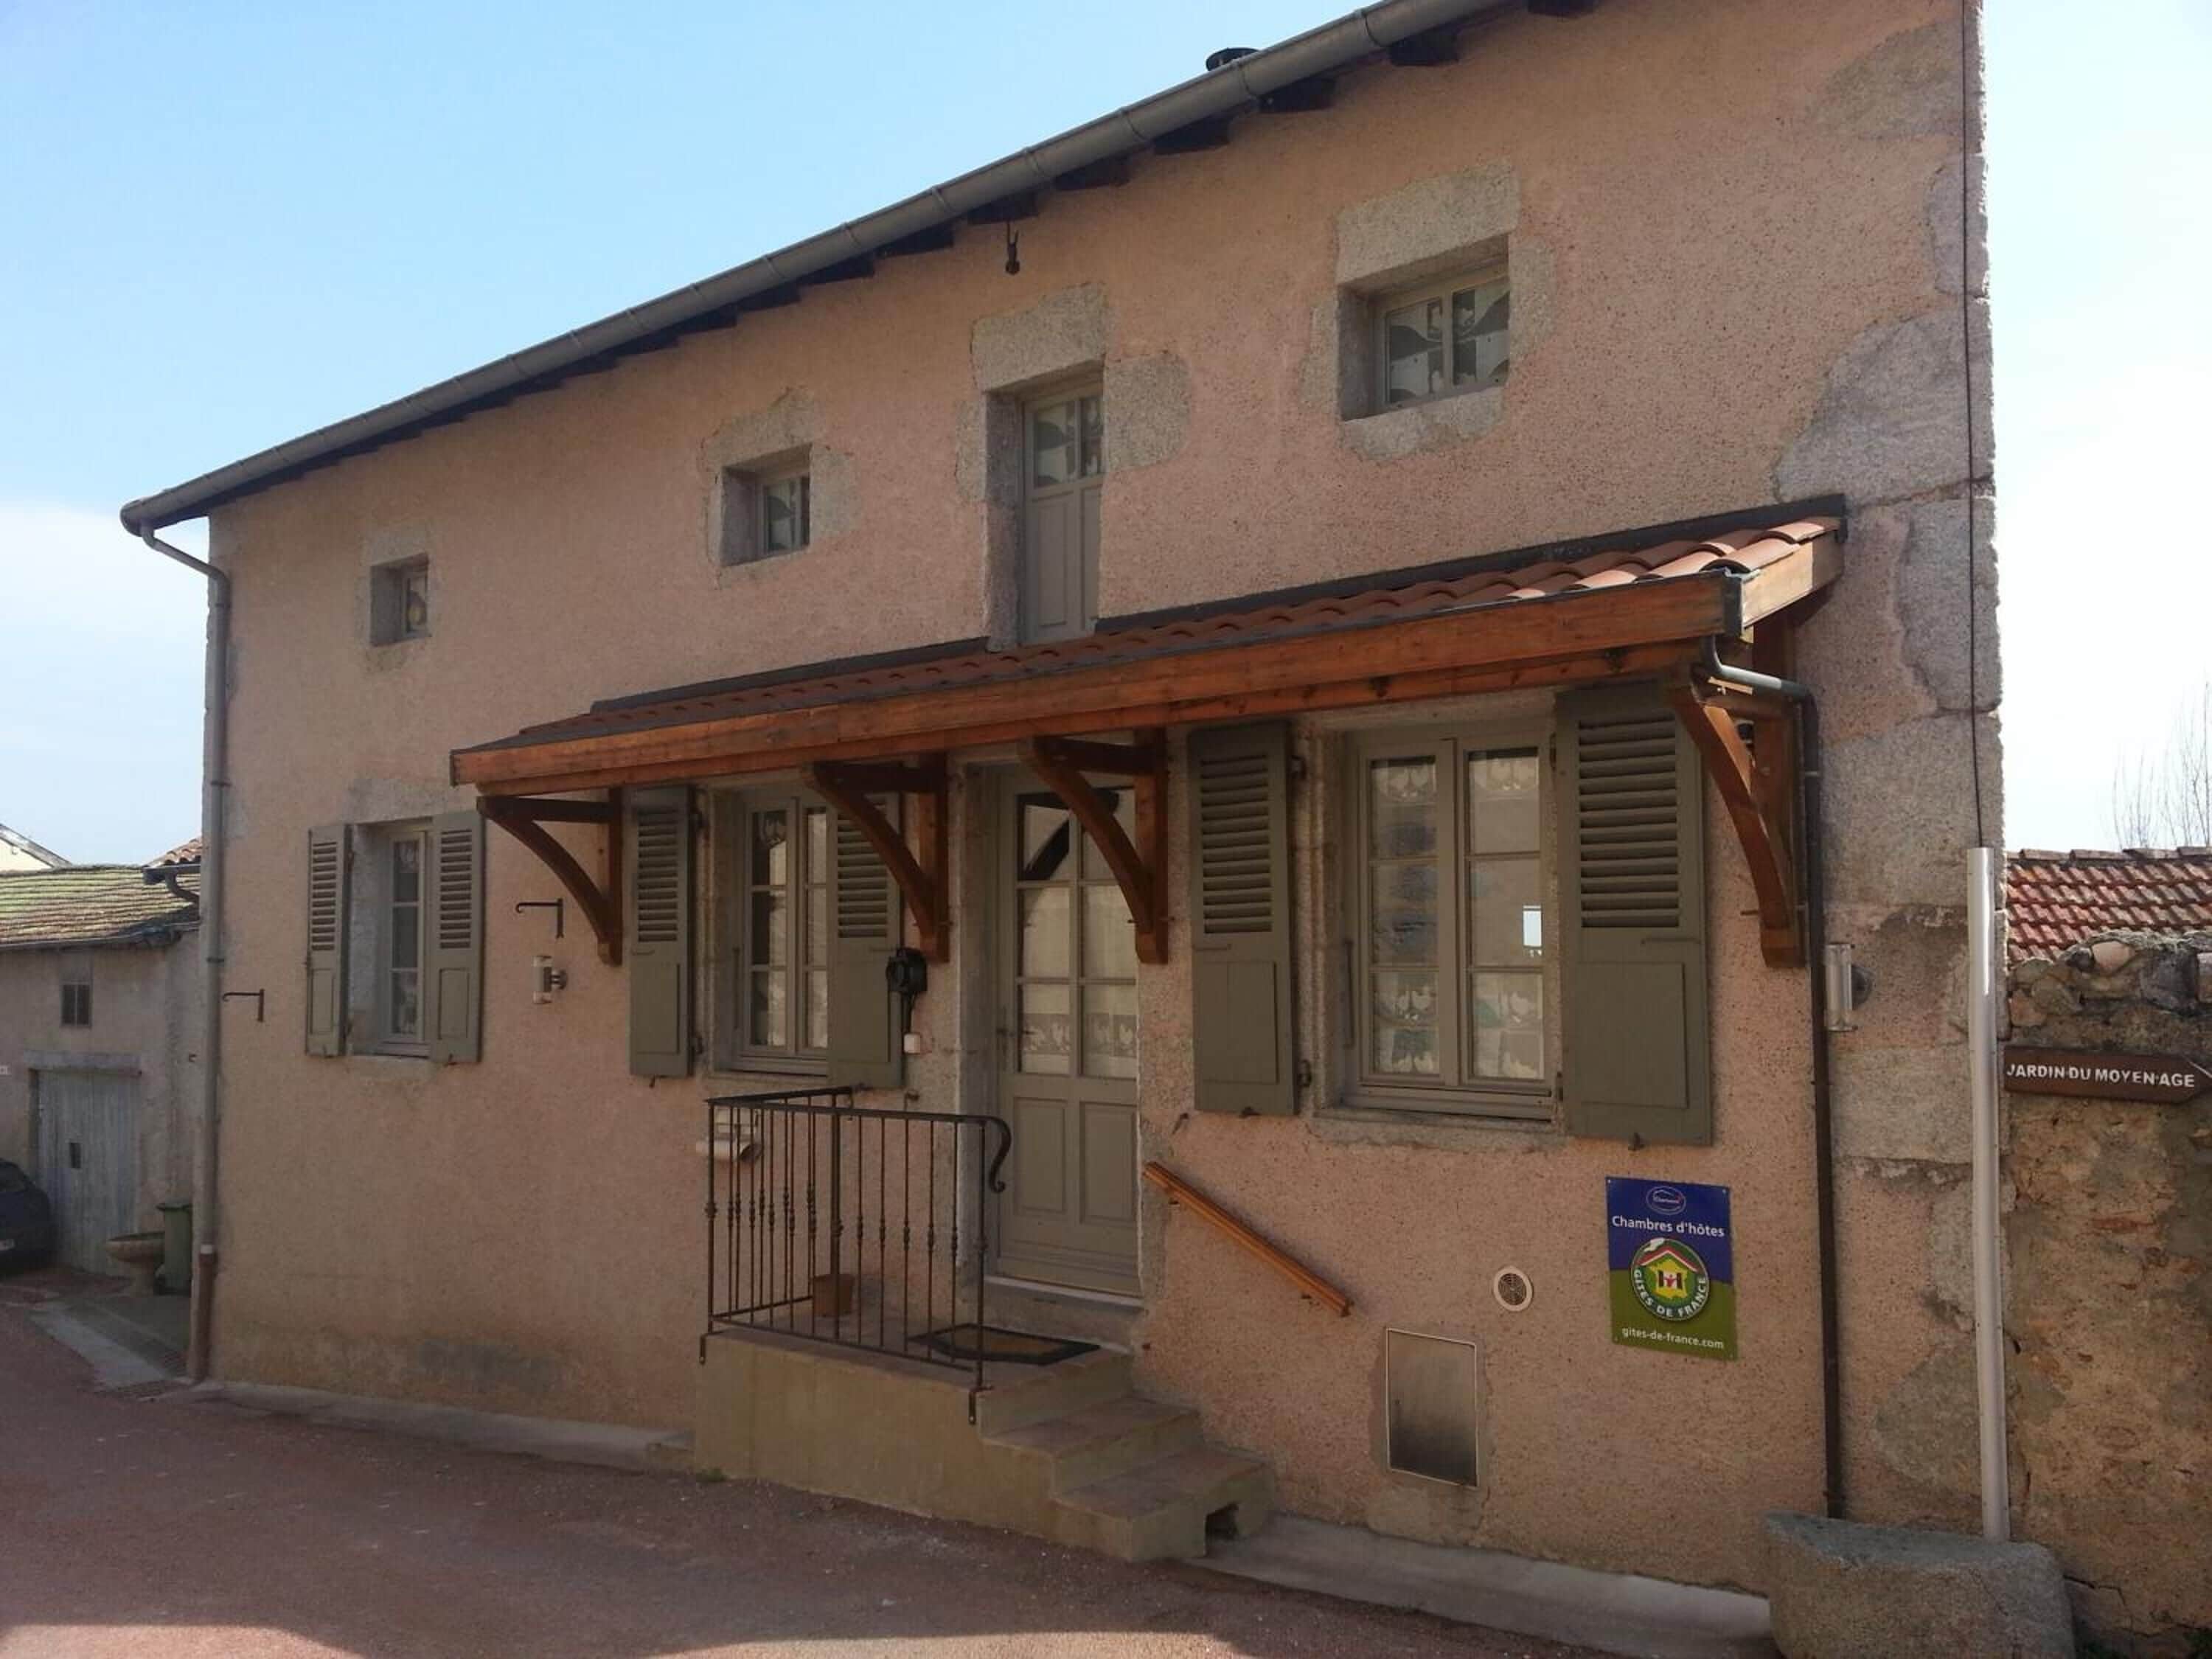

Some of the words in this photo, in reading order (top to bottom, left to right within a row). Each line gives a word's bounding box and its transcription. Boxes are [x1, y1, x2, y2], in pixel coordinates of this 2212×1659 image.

[2006, 1063, 2065, 1079] JARDIN
[2068, 1066, 2091, 1080] DU
[1612, 1215, 1673, 1232] Chambres
[1676, 1222, 1725, 1237] d'hôtes
[1657, 1304, 1674, 1318] DE
[1677, 1276, 1706, 1318] FRANCE
[1621, 1327, 1725, 1349] gites-de-france.com
